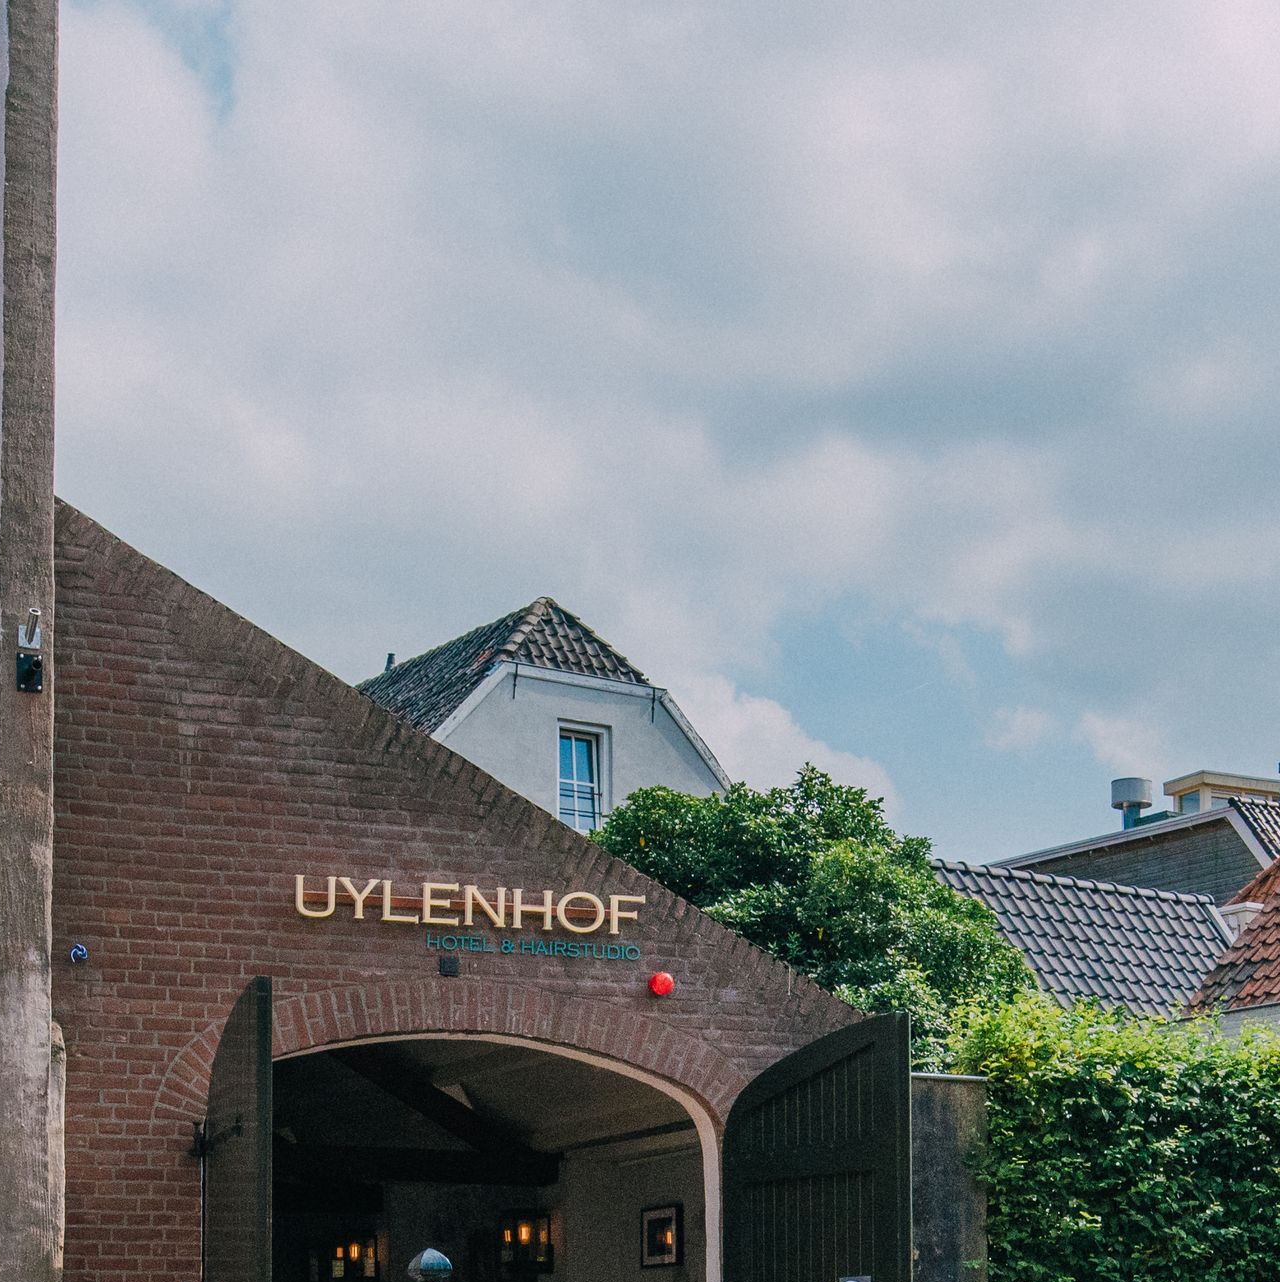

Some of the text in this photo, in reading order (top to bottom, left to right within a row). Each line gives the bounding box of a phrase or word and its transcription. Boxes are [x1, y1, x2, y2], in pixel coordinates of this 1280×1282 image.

[295, 874, 646, 934] UYLENHOF
[426, 933, 642, 961] HOTEL & HAIRSTUDIO
